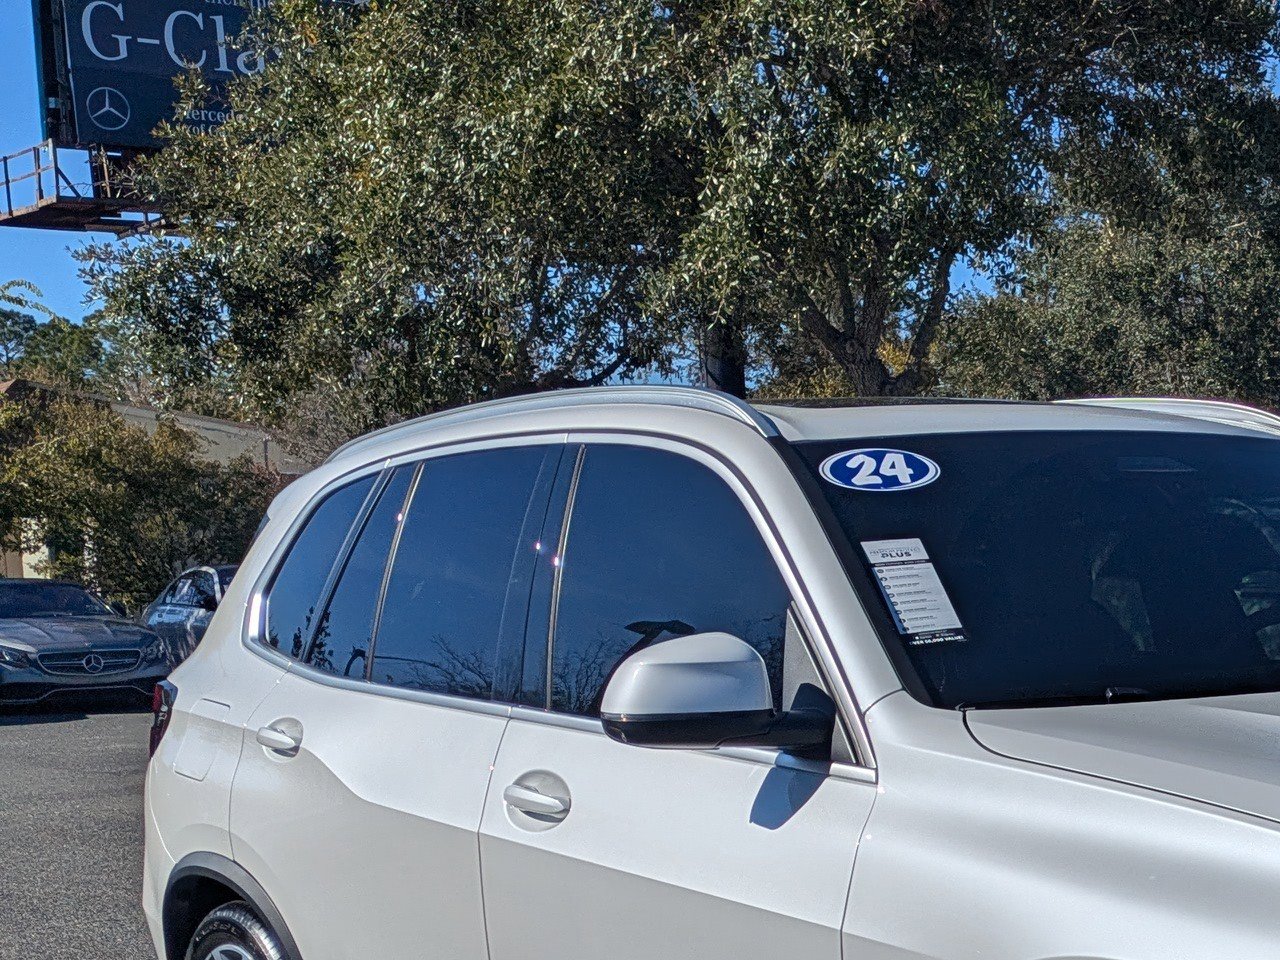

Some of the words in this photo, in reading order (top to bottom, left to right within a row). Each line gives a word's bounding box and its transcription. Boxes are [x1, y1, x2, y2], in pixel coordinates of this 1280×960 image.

[81, 0, 284, 76] G-Cla
[846, 453, 914, 486] 24
[880, 551, 912, 559] PLUS
